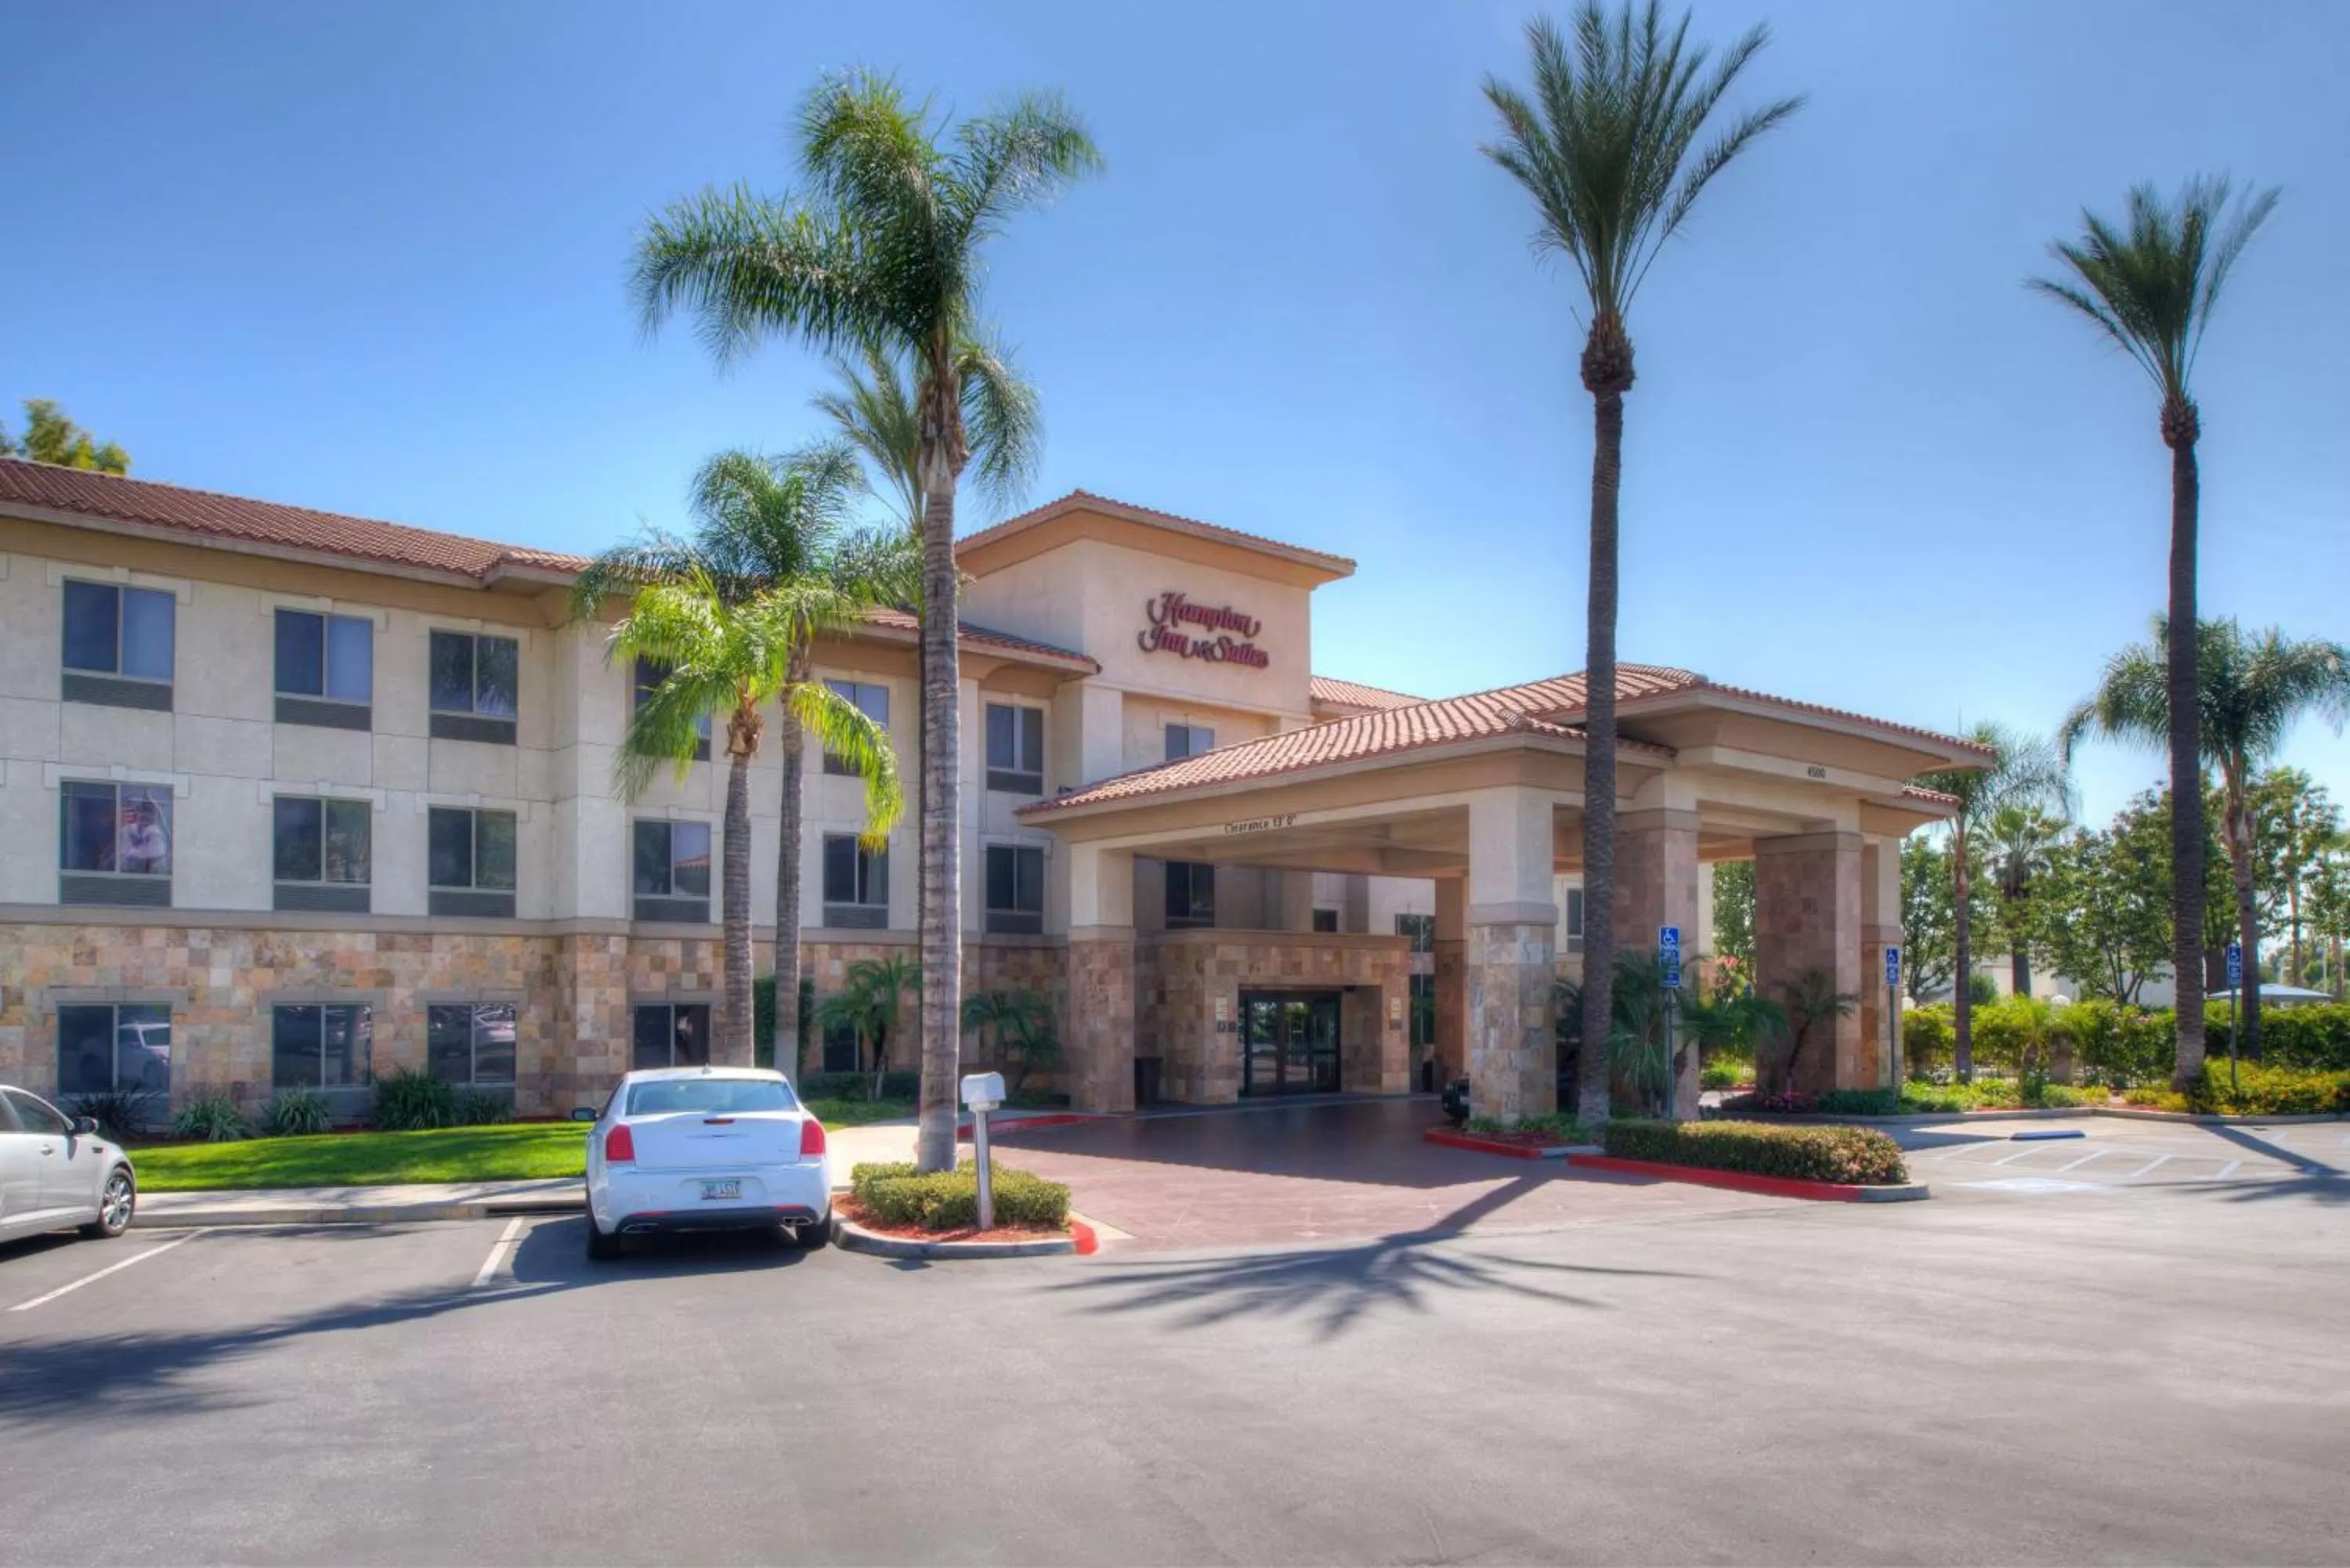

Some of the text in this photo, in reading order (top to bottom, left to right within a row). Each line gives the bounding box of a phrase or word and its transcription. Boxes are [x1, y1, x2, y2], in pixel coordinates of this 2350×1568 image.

[1147, 593, 1261, 638] Hampton
[1138, 625, 1195, 659] Inn
[1212, 635, 1269, 668] Suites
[1224, 820, 1268, 834] Clearance
